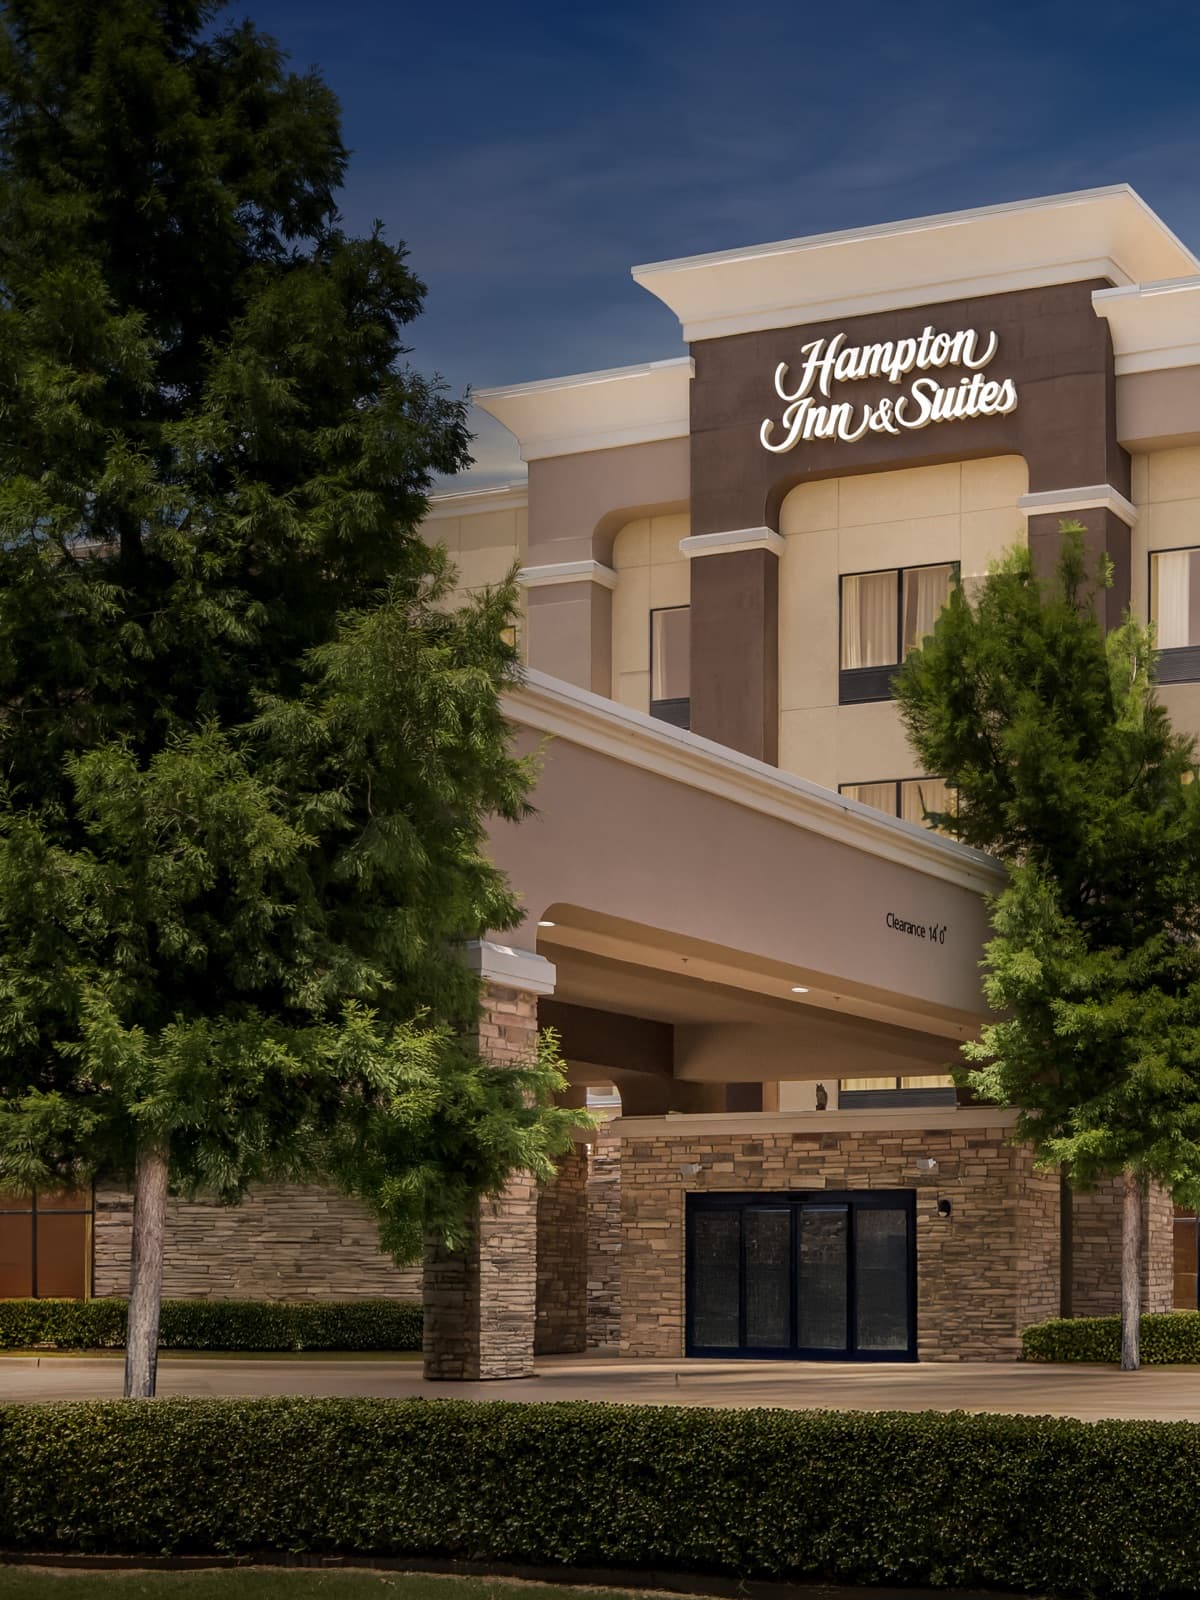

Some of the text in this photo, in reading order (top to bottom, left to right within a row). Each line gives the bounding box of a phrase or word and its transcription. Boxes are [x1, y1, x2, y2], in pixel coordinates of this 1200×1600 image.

[775, 325, 998, 401] Hampton
[760, 372, 1018, 453] Inn & Suites
[886, 912, 926, 938] Clearance
